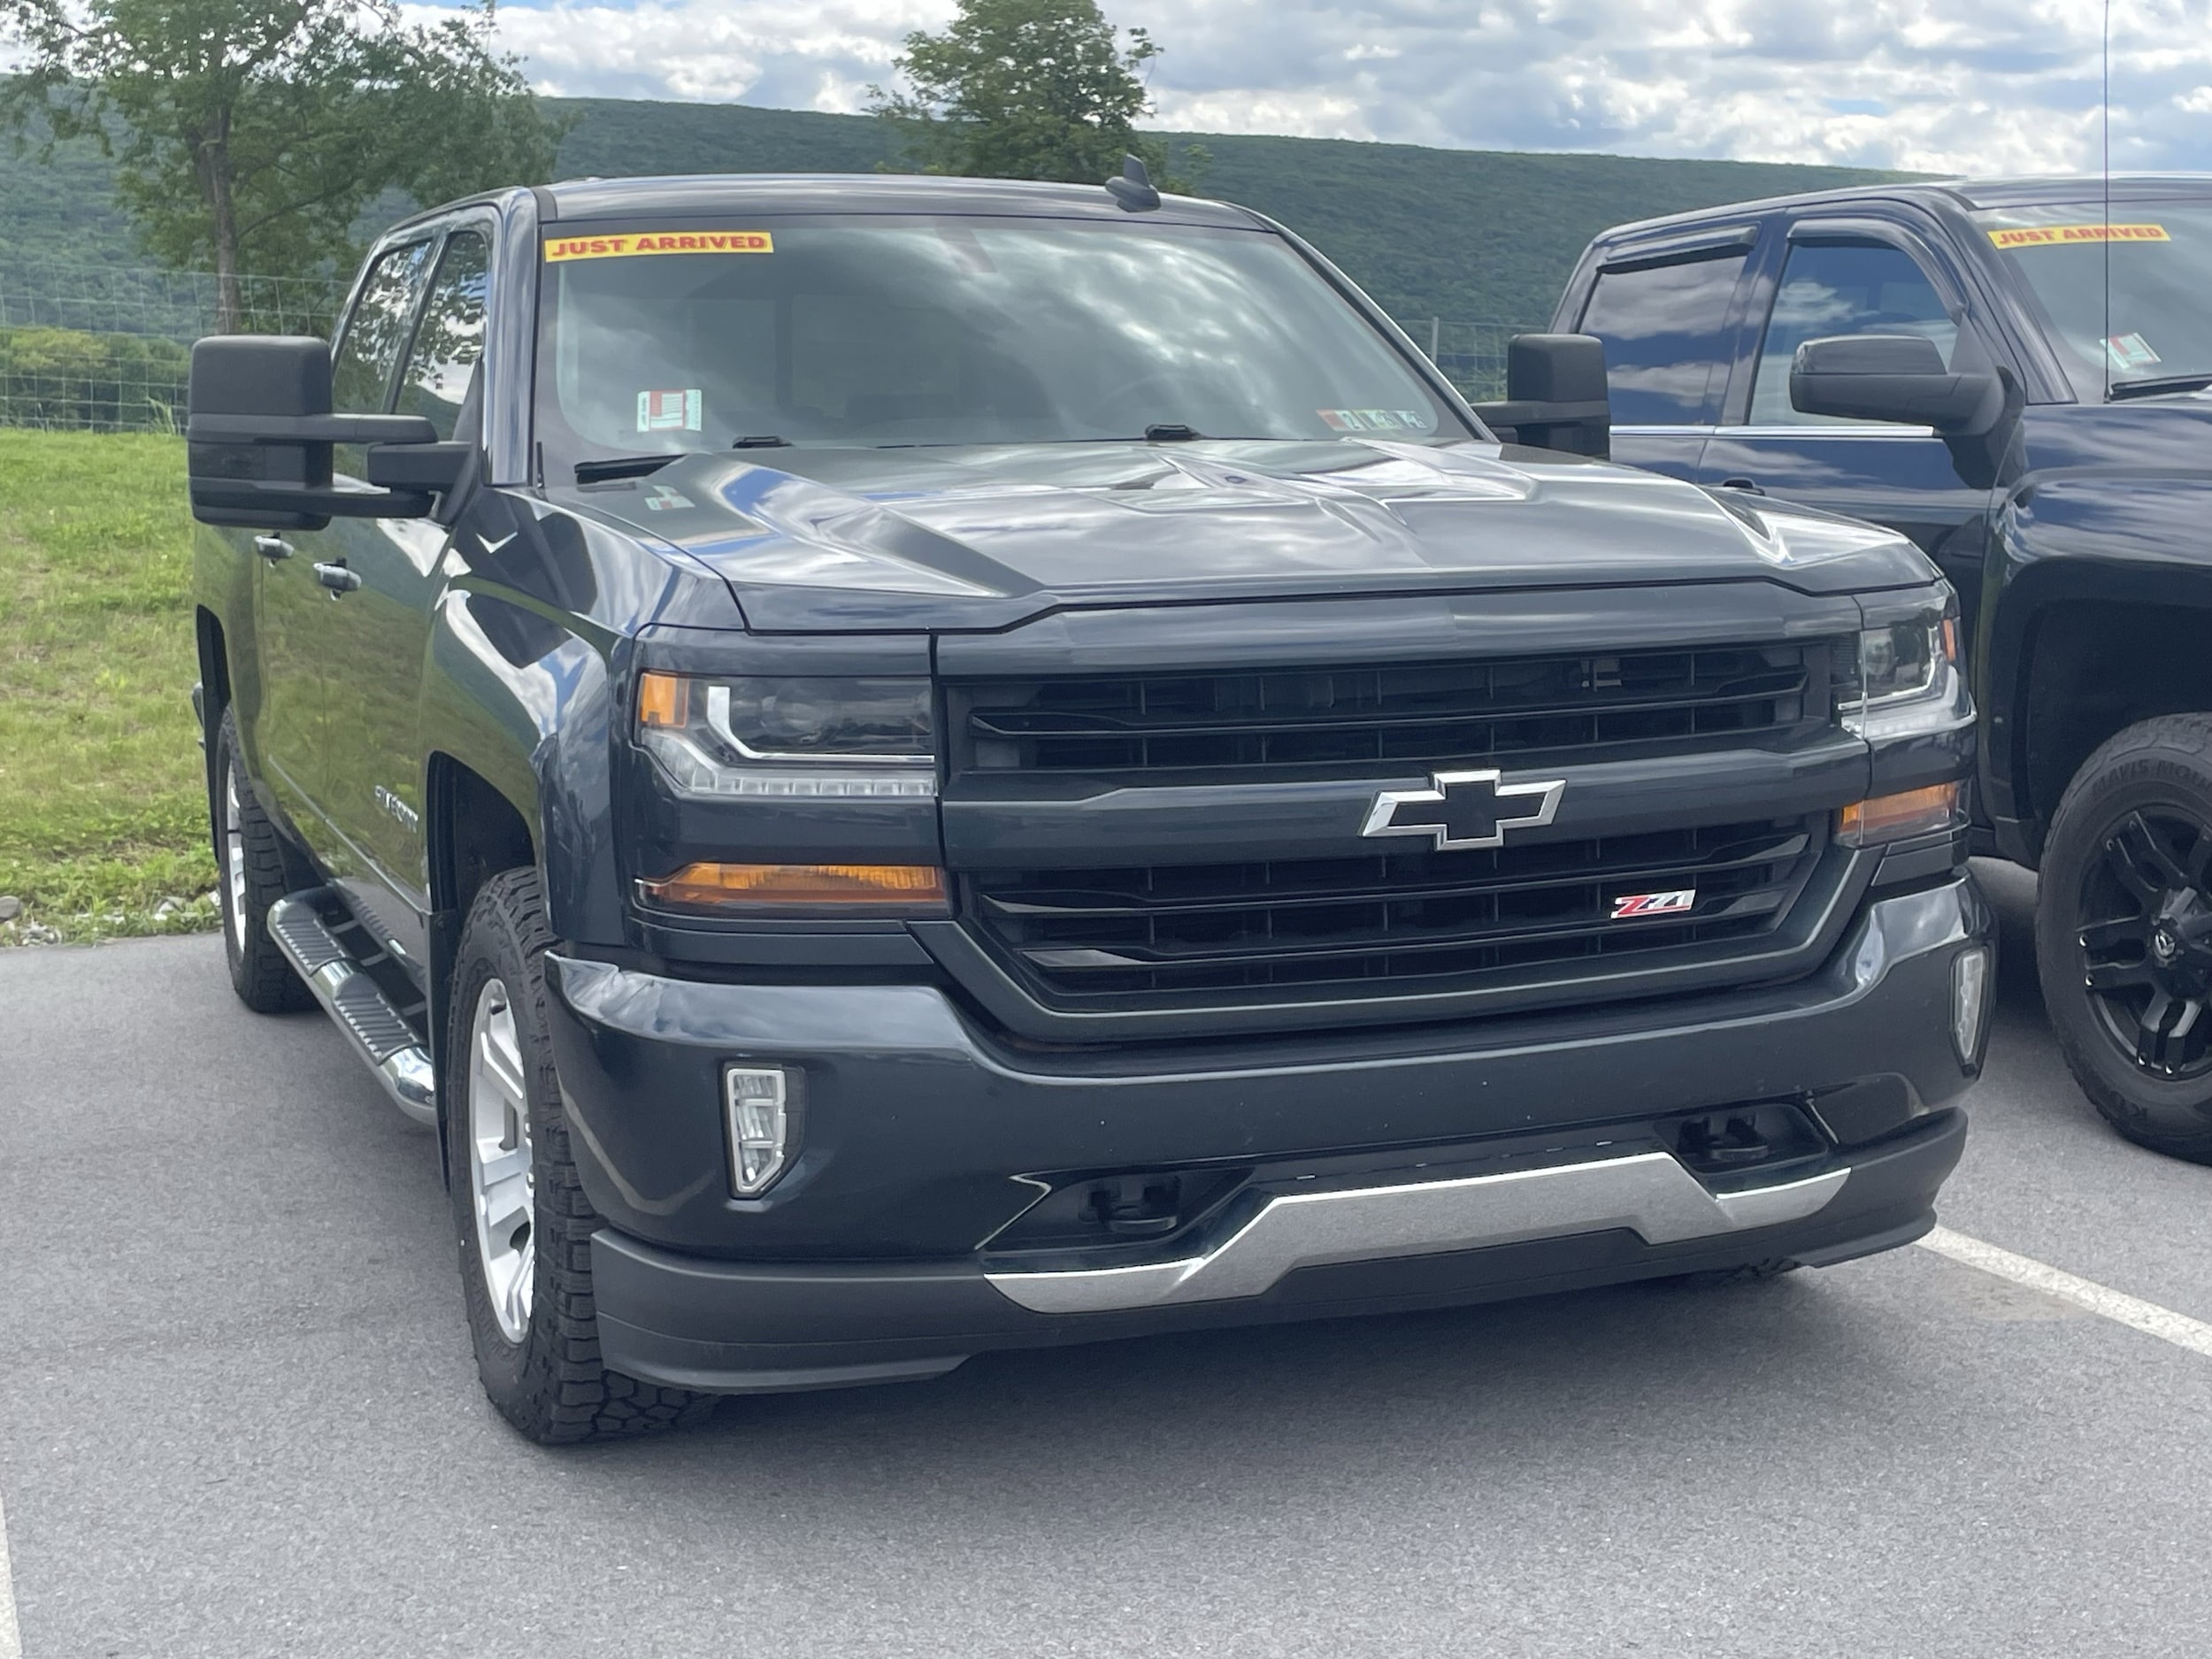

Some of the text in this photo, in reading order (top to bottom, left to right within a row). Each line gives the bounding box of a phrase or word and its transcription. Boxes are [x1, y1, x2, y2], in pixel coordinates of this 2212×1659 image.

[552, 236, 767, 256] JUST ARRIVED
[1999, 227, 2162, 245] JUST ARRIVED
[1610, 889, 1696, 918] Z71
